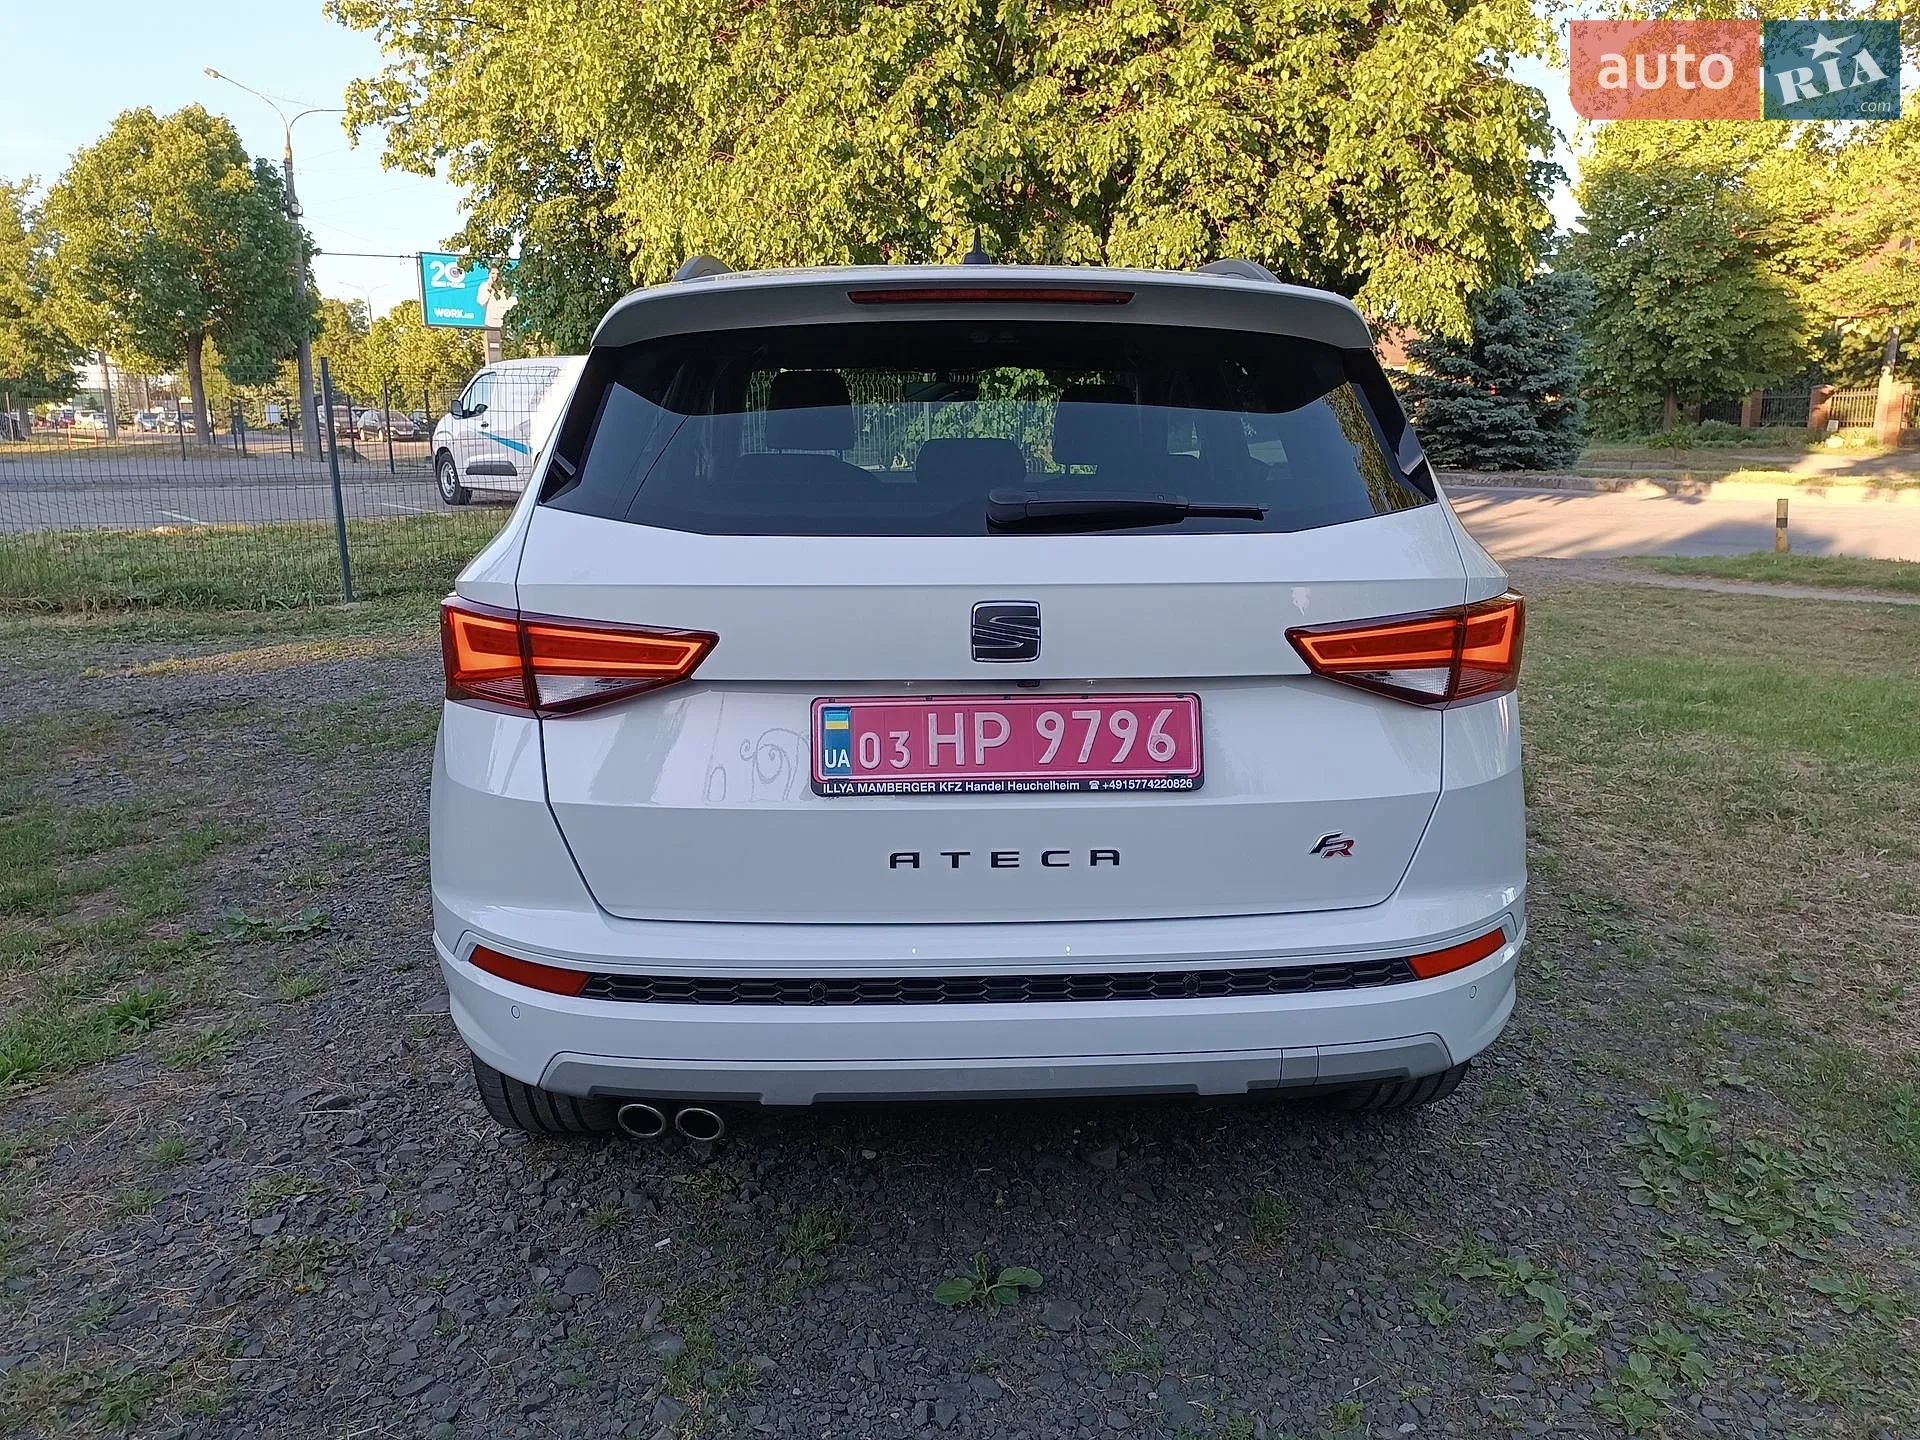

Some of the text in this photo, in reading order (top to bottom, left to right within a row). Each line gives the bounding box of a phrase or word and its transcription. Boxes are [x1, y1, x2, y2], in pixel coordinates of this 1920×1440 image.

[859, 708, 1177, 769] 03 HP 9796
[824, 749, 851, 768] UA
[823, 778, 1193, 794] ILLYA MAMBERGER KFZ Handel Heuchelheim +4915774220826
[889, 849, 1121, 869] ATECA
